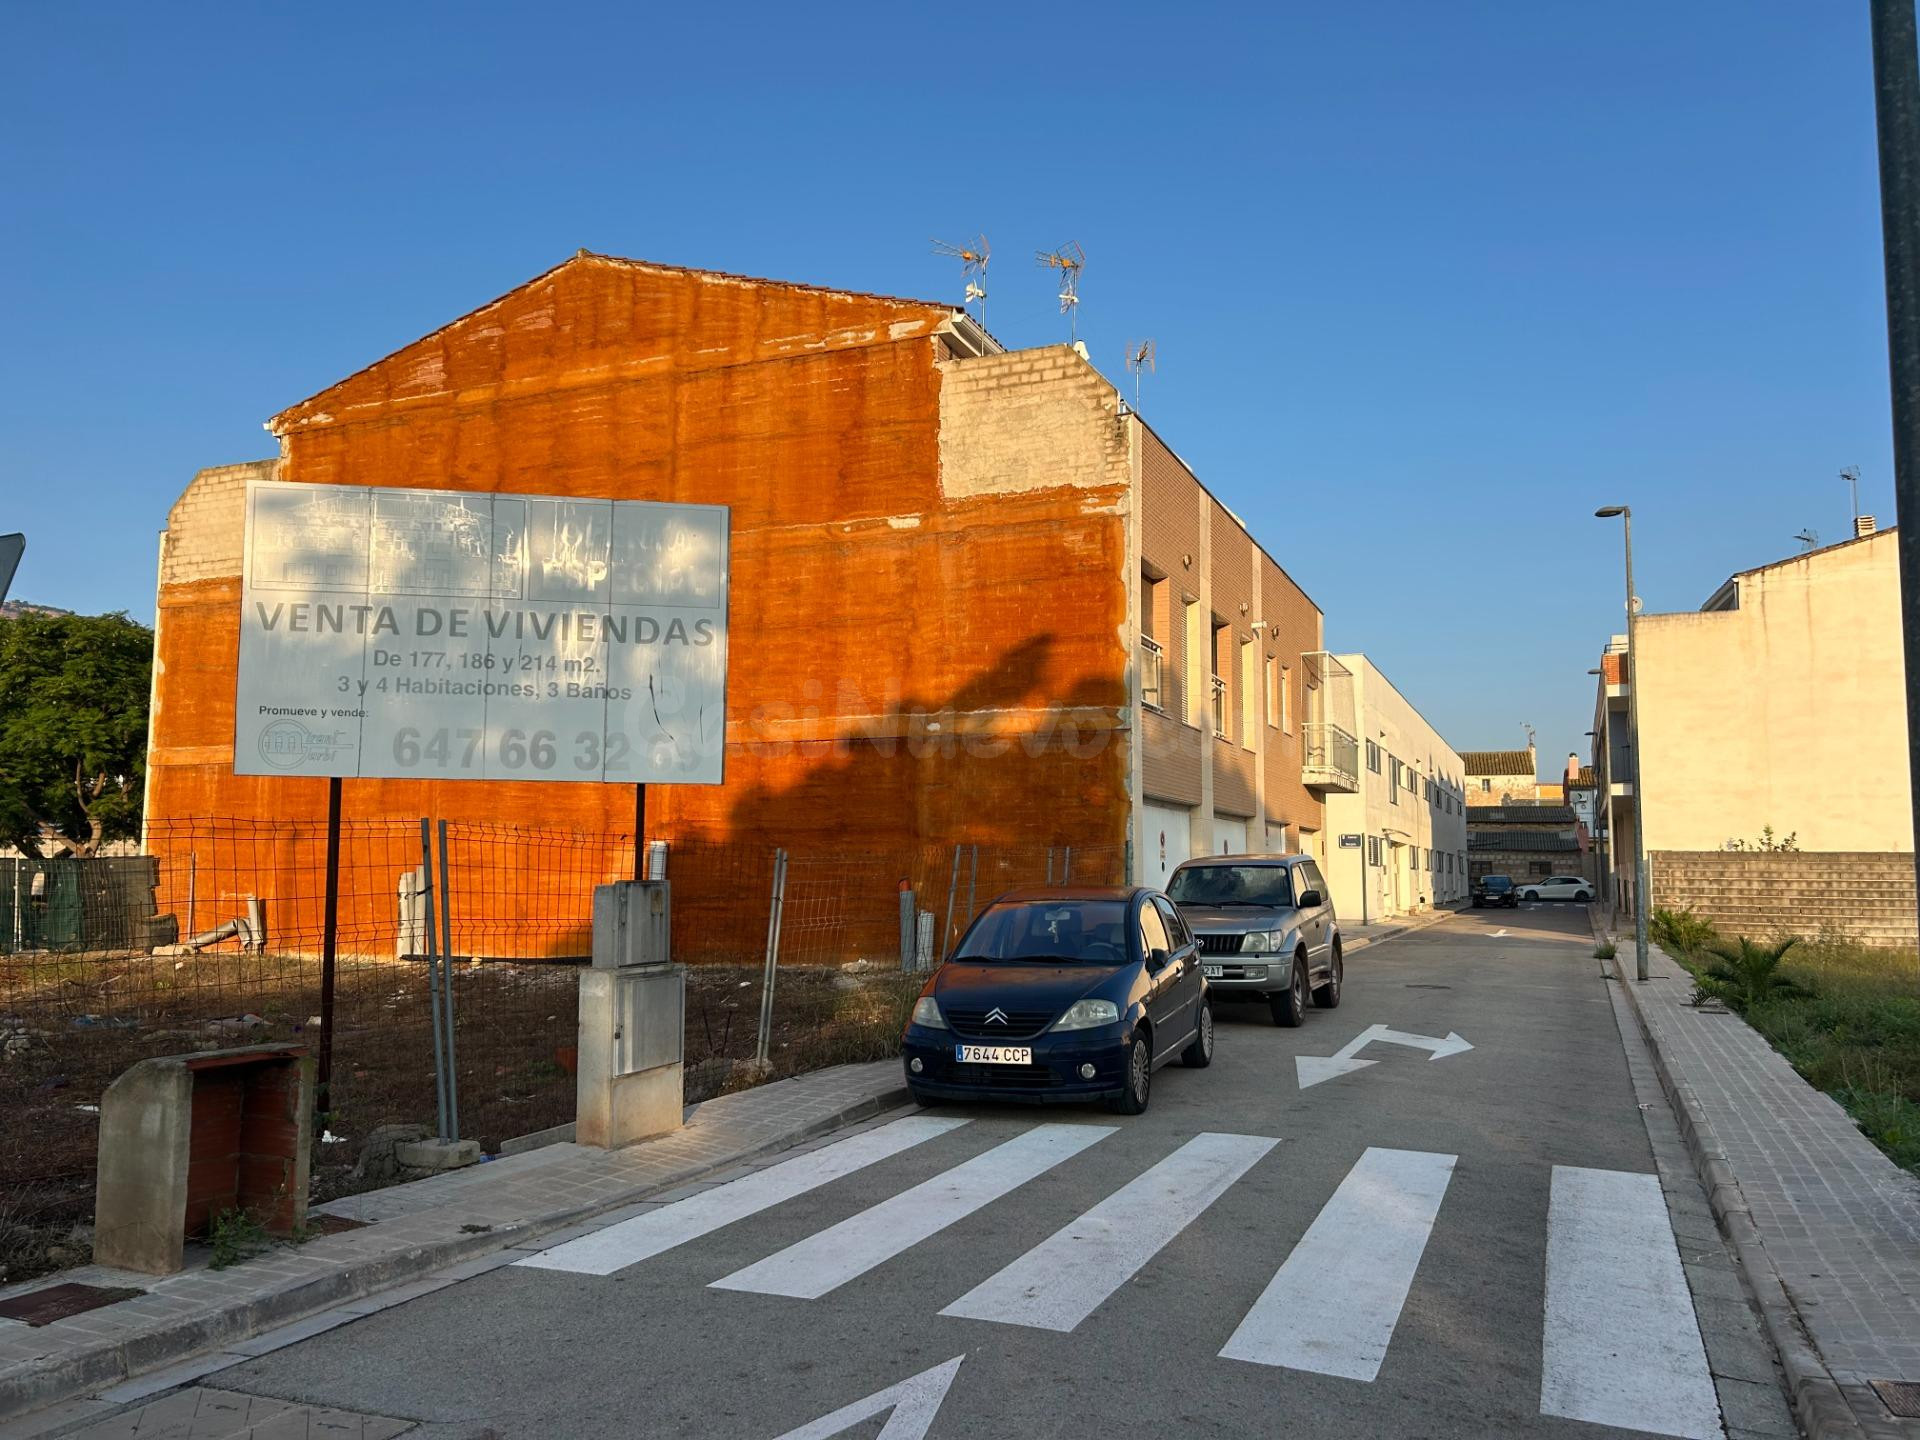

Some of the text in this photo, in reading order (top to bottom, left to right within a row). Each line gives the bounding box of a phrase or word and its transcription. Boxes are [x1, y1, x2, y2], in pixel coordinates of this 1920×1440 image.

[256, 601, 713, 647] VENTA DE VIVIENDAS
[373, 650, 402, 667] De
[409, 651, 451, 671] 177,
[460, 653, 495, 670] 186
[502, 656, 514, 673] y
[521, 654, 556, 671] 214
[338, 676, 632, 701] 3 y 4 Habitaciones, 3 Baños
[259, 705, 369, 719] Promueve y vende:
[393, 727, 483, 769] 647
[499, 728, 557, 771] 66
[573, 730, 632, 772] 32
[964, 1047, 1029, 1062] 7644 CCP
